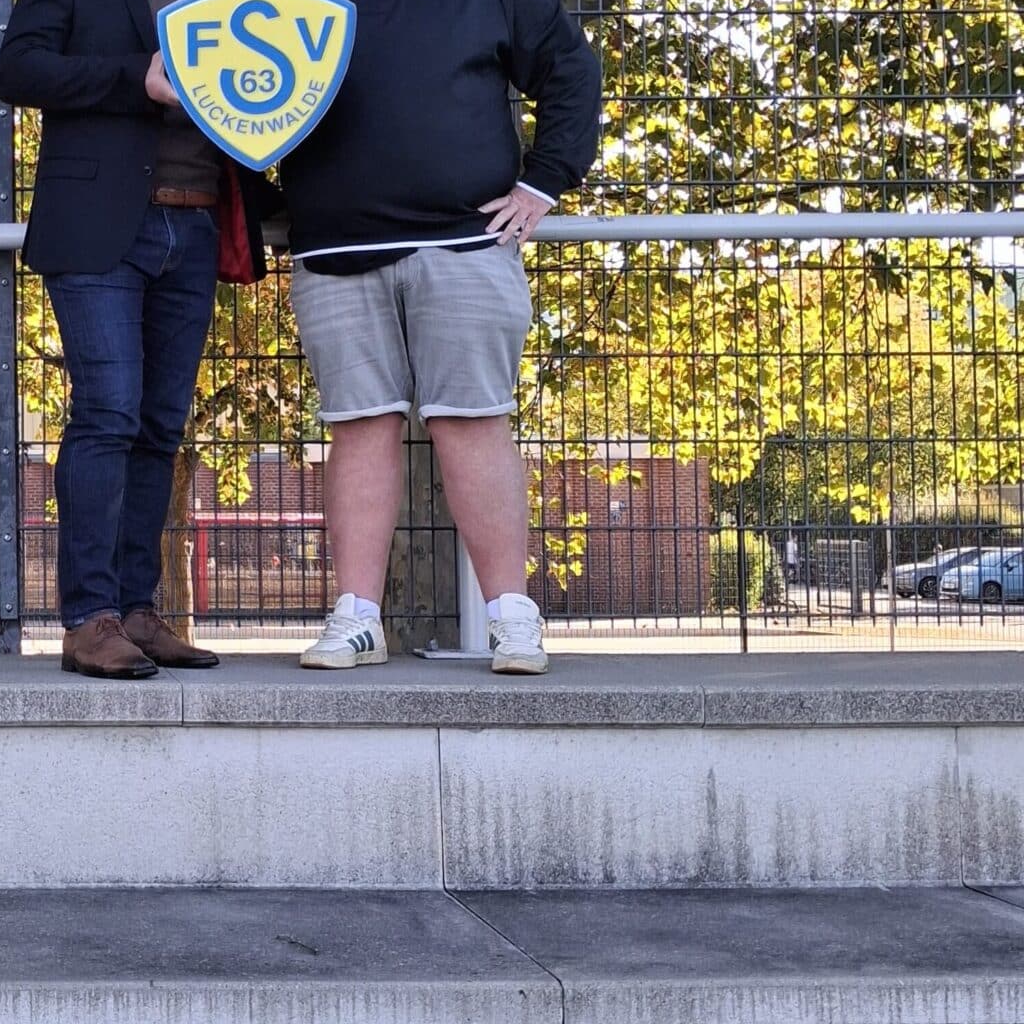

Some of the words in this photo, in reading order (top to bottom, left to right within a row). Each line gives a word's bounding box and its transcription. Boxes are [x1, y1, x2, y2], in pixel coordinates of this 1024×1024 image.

[186, 0, 335, 114] FSV
[240, 70, 275, 94] 63
[191, 79, 325, 135] LUCKENWALDE
